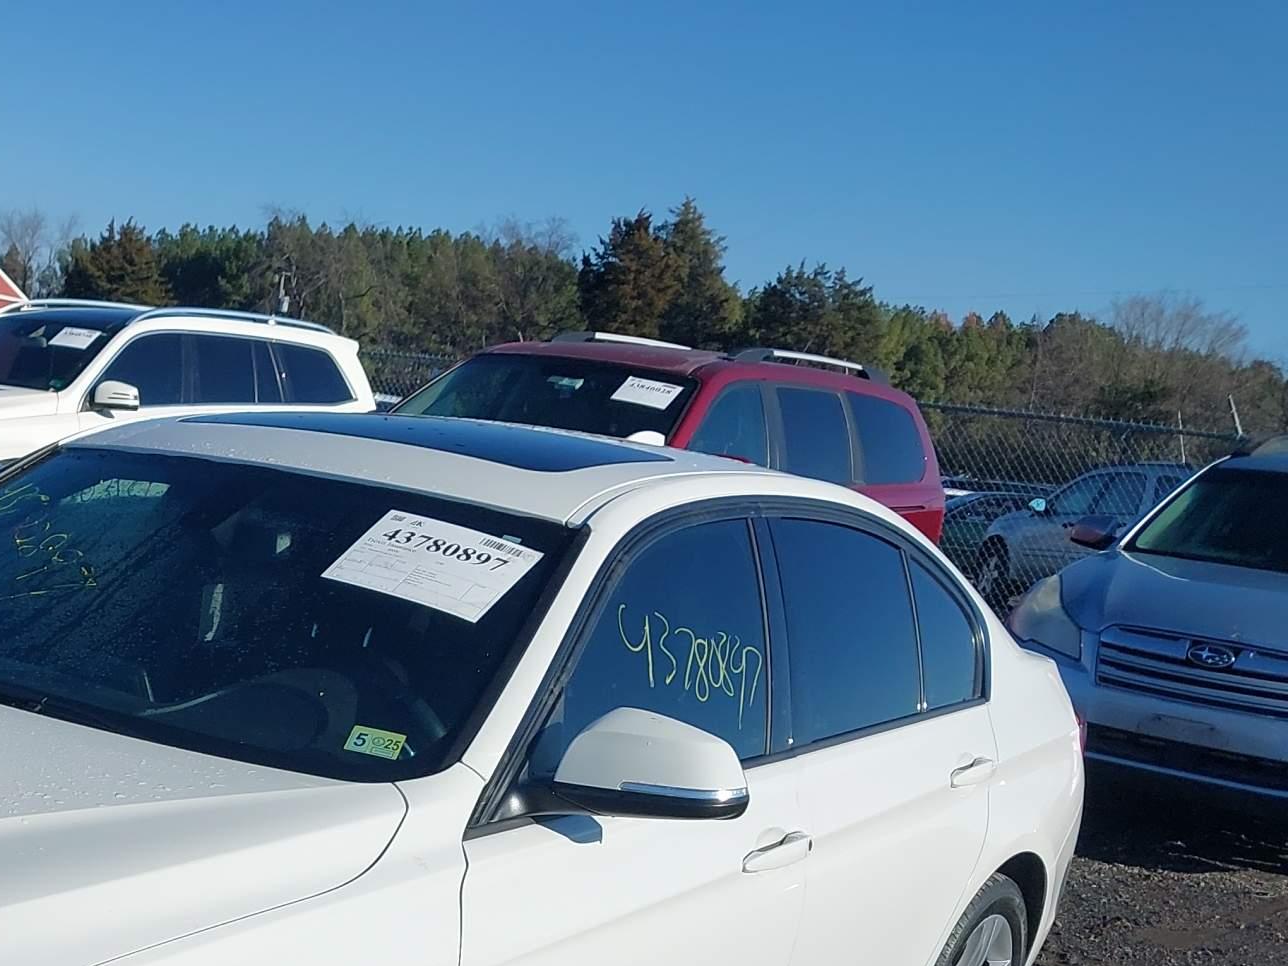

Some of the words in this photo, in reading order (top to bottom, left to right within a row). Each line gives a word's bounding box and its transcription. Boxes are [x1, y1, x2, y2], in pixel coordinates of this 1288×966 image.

[381, 528, 510, 572] 43780897
[353, 732, 369, 747] 5
[383, 738, 402, 751] 25
